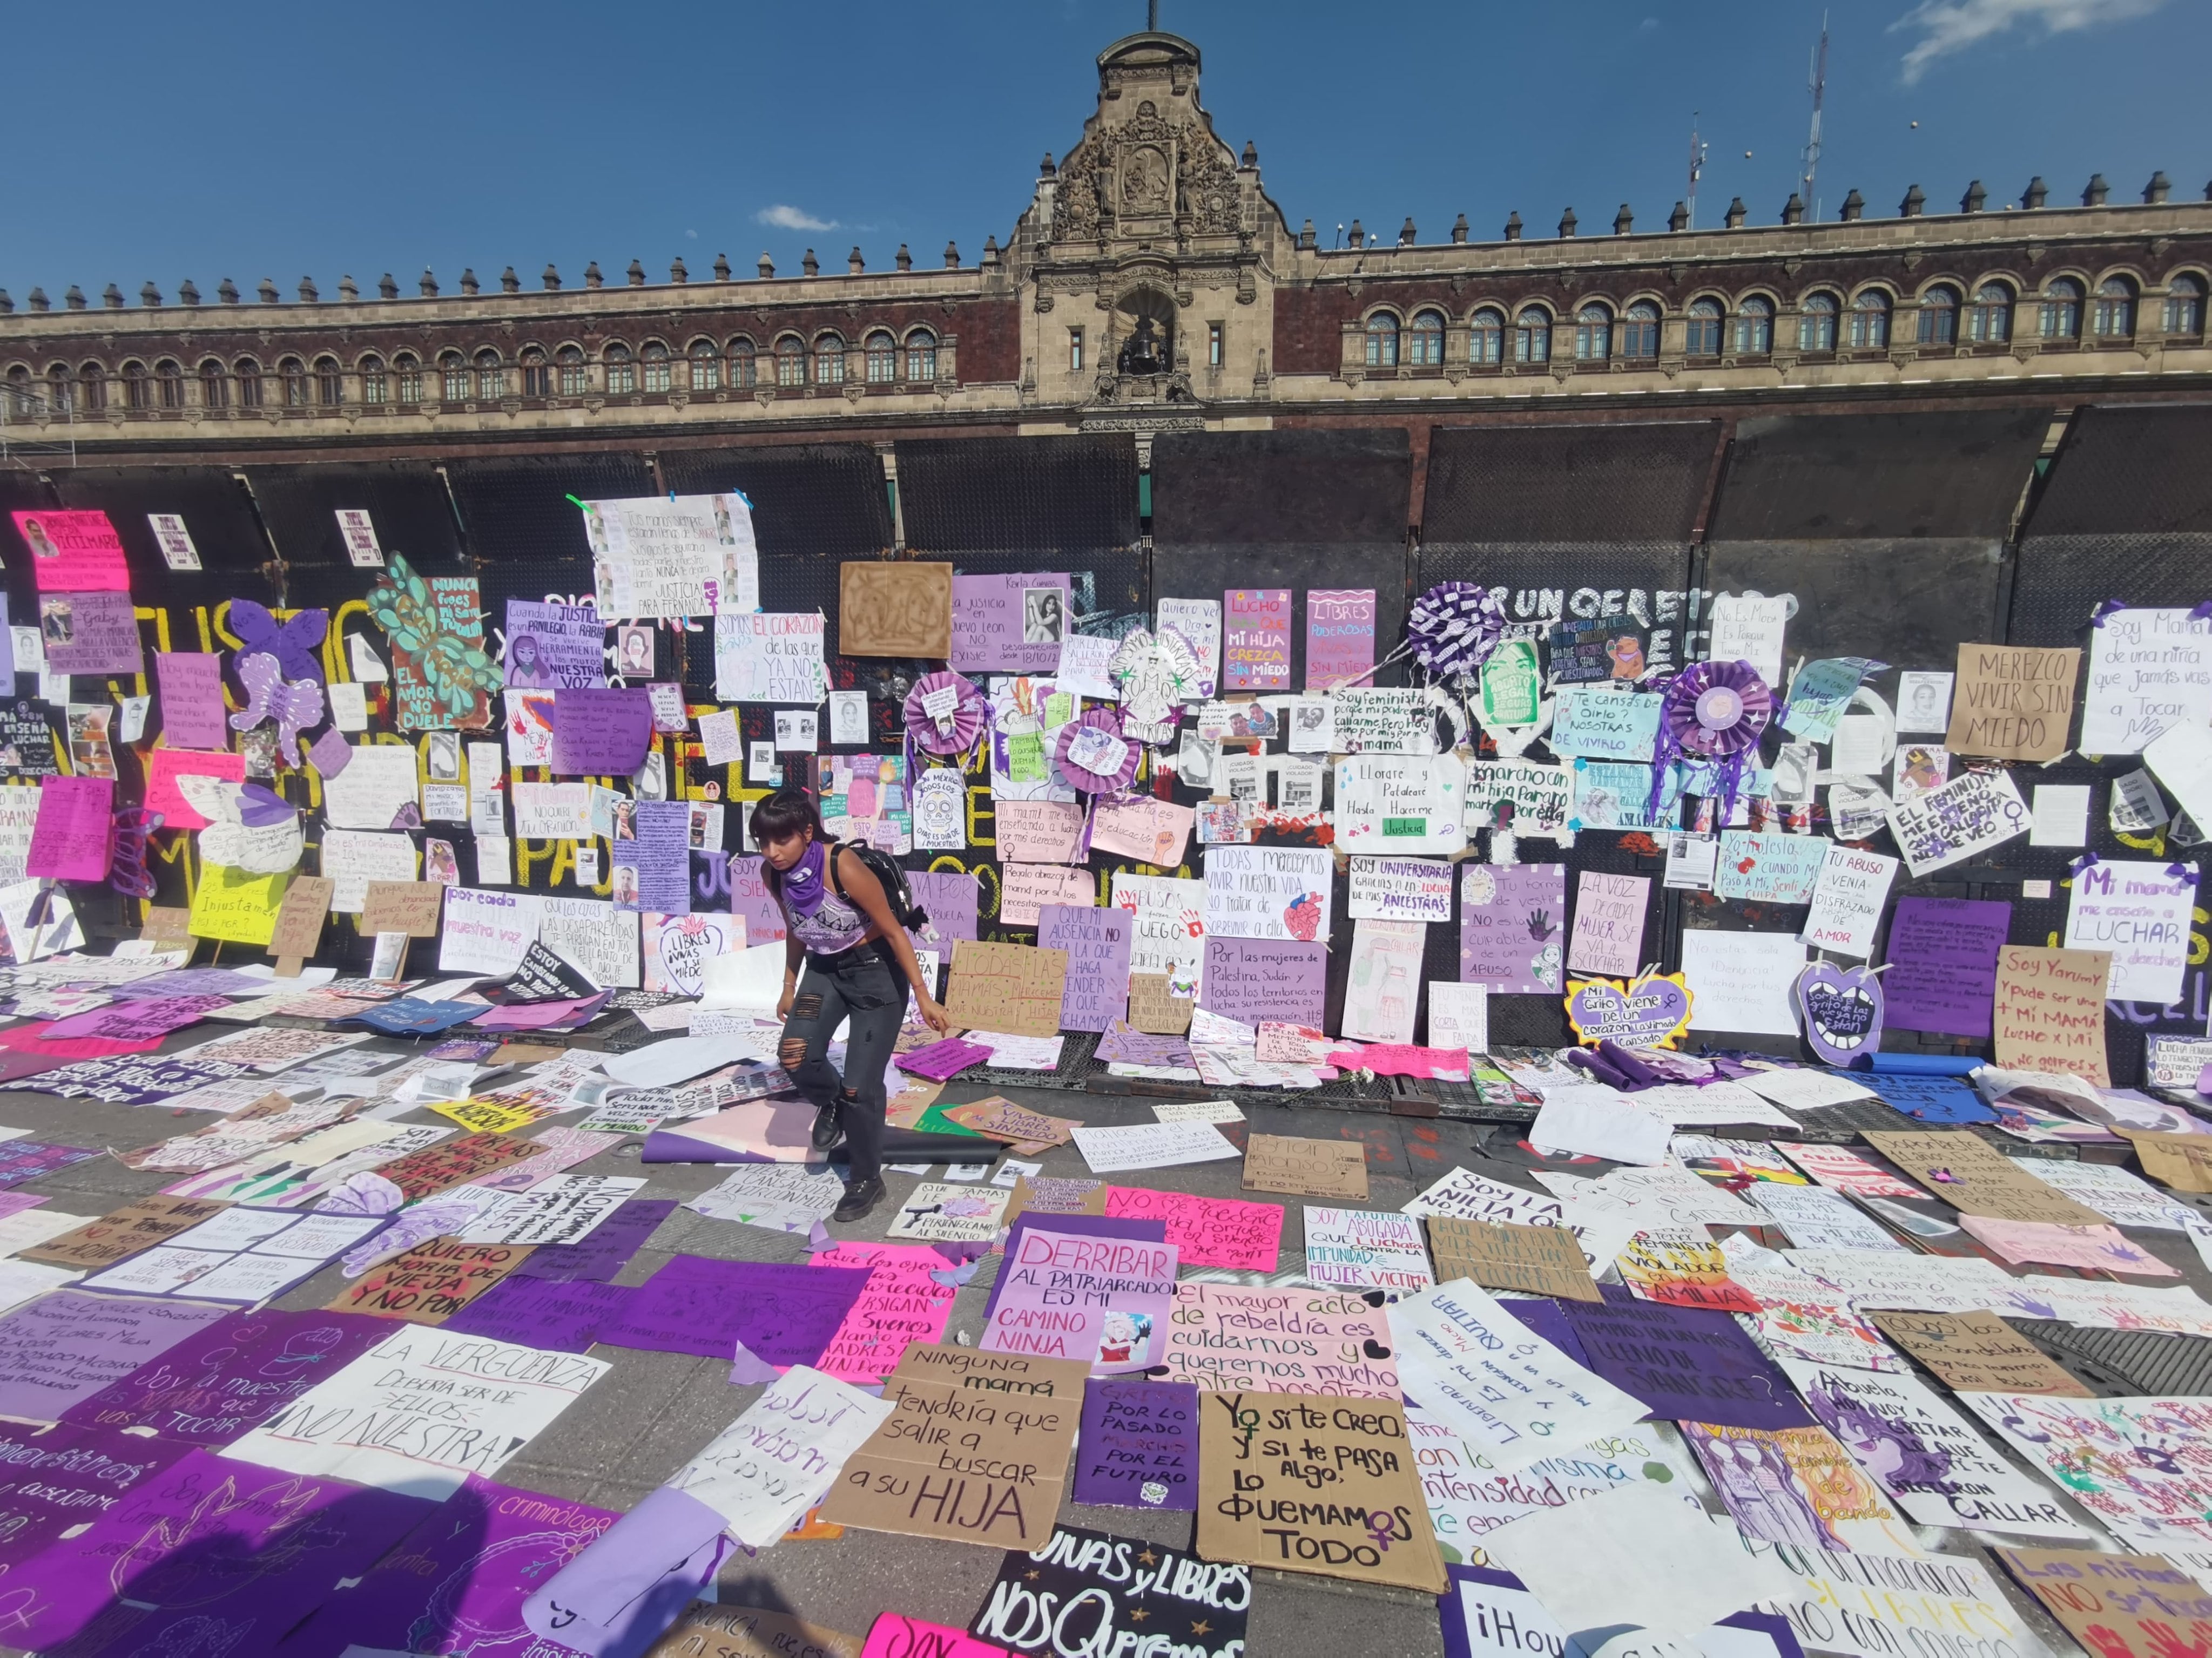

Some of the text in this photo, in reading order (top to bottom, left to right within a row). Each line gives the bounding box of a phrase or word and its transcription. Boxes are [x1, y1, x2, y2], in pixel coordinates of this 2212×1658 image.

[433, 578, 478, 593] NUNCA
[656, 583, 702, 599] JUSTICIA
[509, 604, 545, 619] Cuando
[549, 606, 556, 619] la
[639, 599, 707, 615] PARA FERNANDA
[1232, 598, 1279, 612] LUCHO
[570, 625, 576, 635] la
[579, 625, 605, 639] RABIA
[718, 614, 751, 635] SOMOS
[753, 615, 768, 635] EL
[1260, 617, 1286, 630] QUE
[1312, 624, 1374, 637] PODEROSAS
[540, 644, 600, 655] HERRAMIENTA
[765, 637, 819, 655] de las que
[1228, 648, 1283, 661] CREZCA
[398, 667, 416, 684] EL
[550, 664, 603, 678] NUESTRA
[764, 658, 811, 678] YA NO
[1979, 652, 2067, 681] MEREZCO
[561, 676, 592, 688] VOZ
[769, 678, 813, 701] ESTAN
[398, 685, 435, 702] AMOR
[1966, 682, 2069, 714] VIVIR SIN
[411, 700, 431, 715] NO
[404, 713, 454, 728] DUELE
[1570, 720, 1633, 733] NOSOTRAS
[1555, 733, 1626, 750] DE VIVIRLO
[1966, 718, 2046, 748] MIEDO
[1422, 770, 1428, 781] y
[1383, 783, 1426, 797] Patalearé
[997, 803, 1007, 816] Mi
[1049, 811, 1060, 820] me
[1065, 813, 1079, 822] esta
[1347, 800, 1374, 814] Hasta
[1000, 820, 1044, 831] enseñando
[1385, 820, 1423, 835] Justicia
[1000, 833, 1065, 846] por mis derechos
[1210, 848, 1324, 875] TODAS merecemos
[1352, 858, 1452, 879] SOY UNIVERSITARIA
[1830, 851, 1883, 875] TU ABUSO
[1240, 872, 1276, 894] nuestra
[1282, 876, 1303, 894] VIDA
[1355, 877, 1449, 893] GRACIAS A LA LUCHA
[1352, 891, 1363, 899] DE
[1366, 891, 1381, 901] MIS
[1816, 894, 1875, 916] DISFRAZADO
[1833, 915, 1845, 925] DE
[1813, 928, 1851, 943] AMOR
[2074, 921, 2179, 944] LUCHAR
[1210, 942, 1318, 965] Por las mujeres de
[1210, 965, 1304, 983] Palestina, Sudán y
[1585, 999, 1614, 1010] Grito
[1347, 1219, 1412, 1241] ABOGADA
[1020, 1235, 1168, 1278] DERRIBAR
[1307, 1246, 1373, 1264] IMPUNIDAD
[385, 1271, 463, 1290] VIEJA
[1011, 1269, 1171, 1295] AL PATRIARCADO
[1310, 1264, 1367, 1284] MUJER
[1042, 1288, 1110, 1307] ES MI
[1177, 1284, 1366, 1315] El mayor acto
[998, 1308, 1086, 1332] CAMINO
[1171, 1304, 1374, 1336] de rebeldía es
[997, 1331, 1065, 1356] NINJA
[1172, 1329, 1359, 1364] cuidarnos y
[428, 1340, 597, 1391] VERGÜENZA
[1167, 1351, 1398, 1388] queremos mucho
[460, 1383, 490, 1400] SER
[491, 1389, 527, 1403] DE
[965, 1375, 1054, 1398] mamá
[1820, 1370, 1907, 1401] Abuela,
[386, 1394, 463, 1421] ELLOS
[1292, 1403, 1326, 1429] te
[1005, 1411, 1059, 1435] que
[1101, 1416, 1182, 1435] PASADO
[960, 1434, 981, 1451] a
[1299, 1439, 1326, 1461] te
[1334, 1445, 1399, 1477] PASA
[1092, 1464, 1187, 1484] FUTURO
[1234, 1470, 1264, 1491] Lo
[849, 1471, 870, 1488] a
[908, 1475, 1027, 1539] HIJA
[1263, 1528, 1380, 1566] TODO
